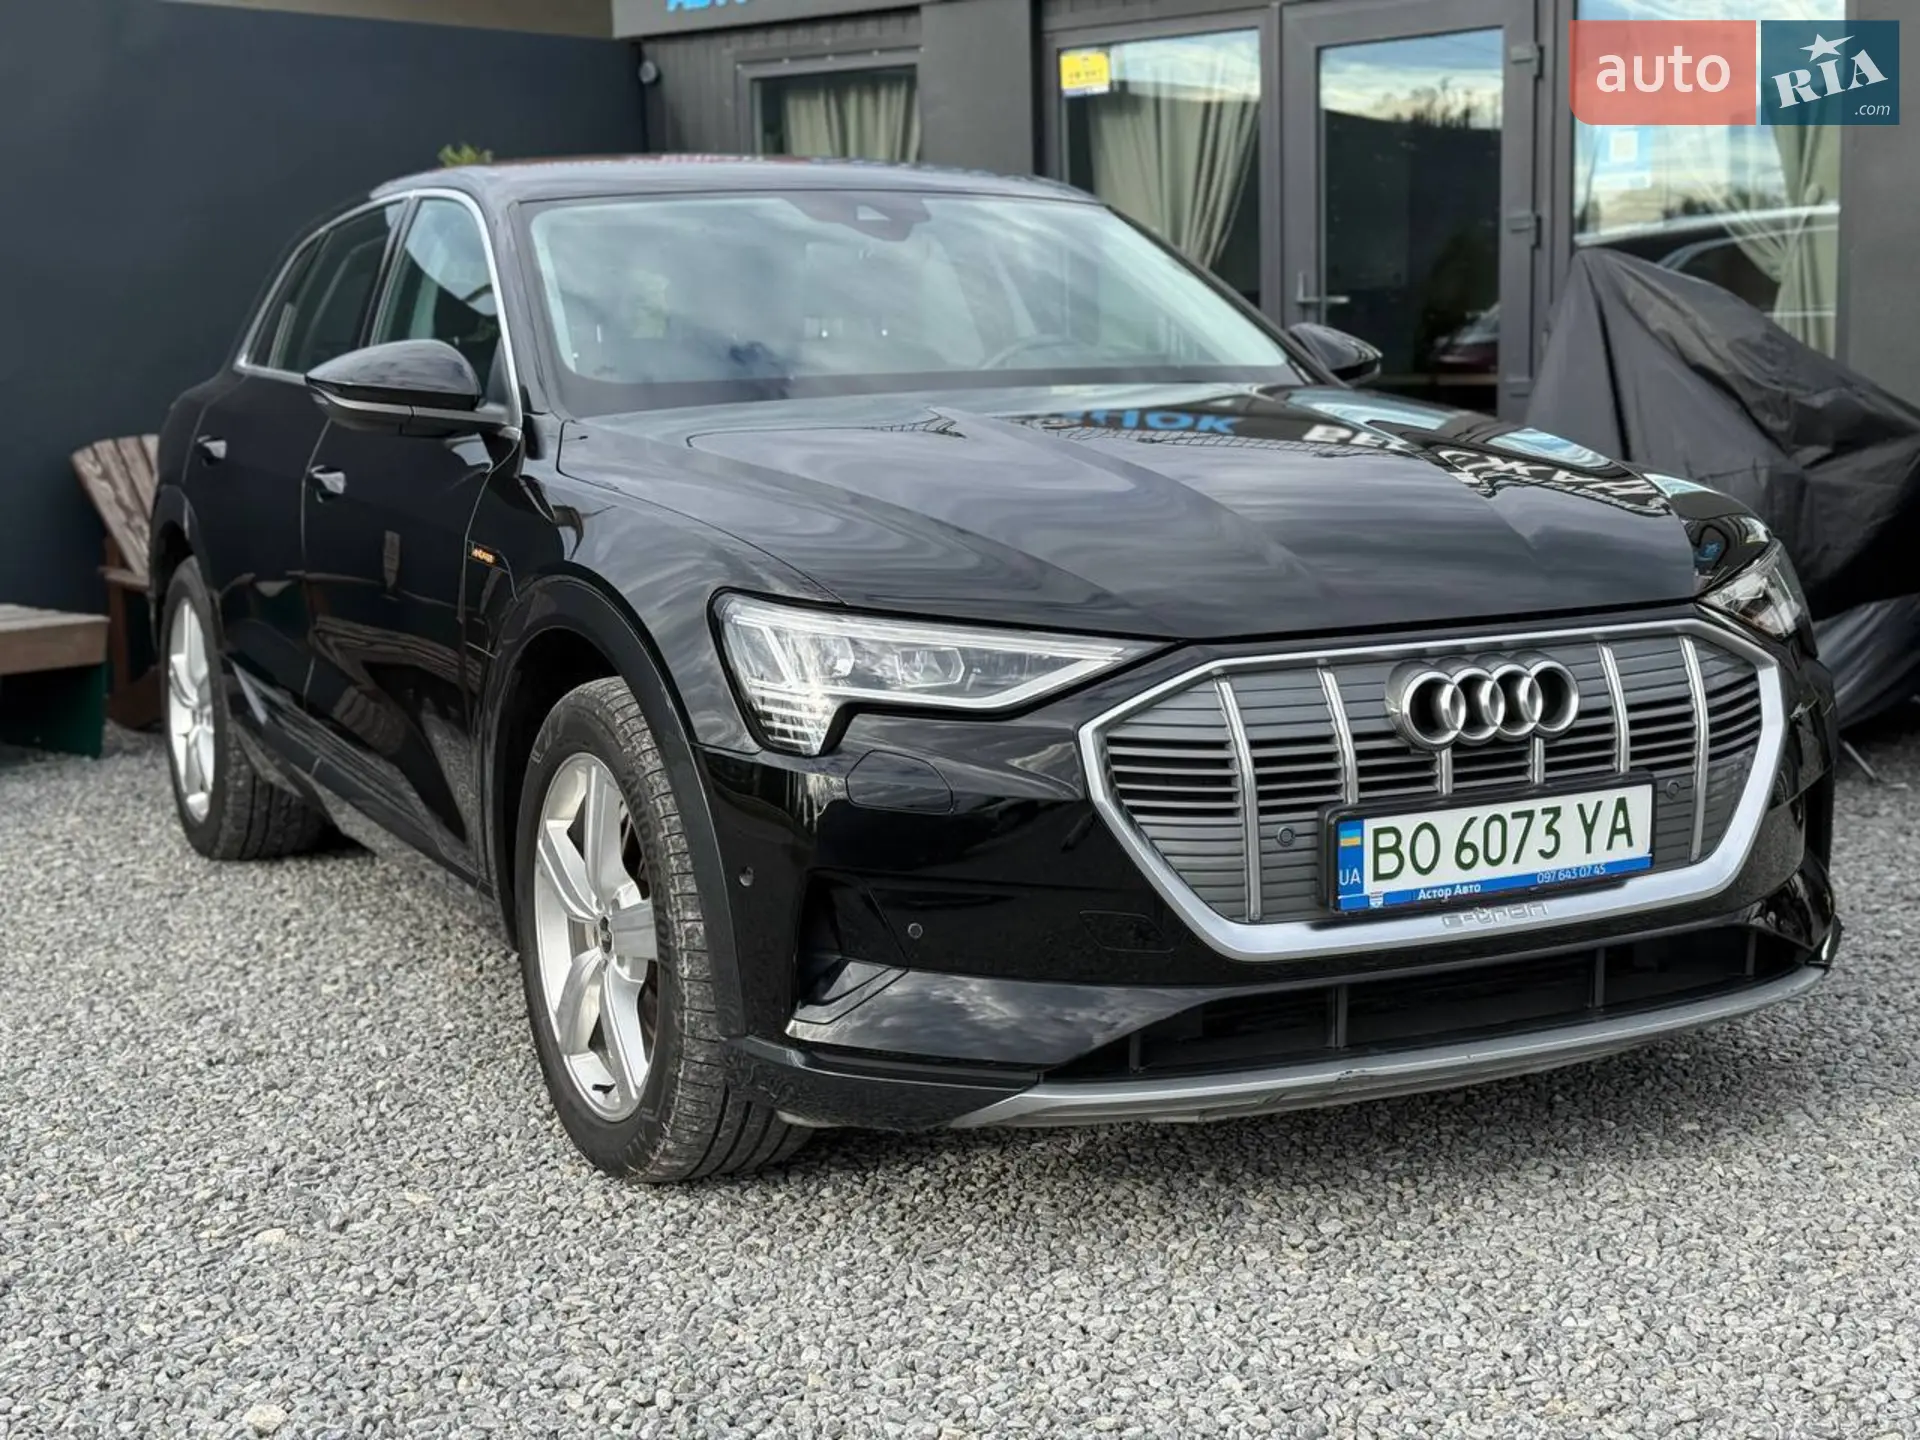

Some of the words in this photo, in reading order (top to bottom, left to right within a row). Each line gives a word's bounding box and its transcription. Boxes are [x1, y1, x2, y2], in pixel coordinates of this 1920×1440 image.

[1373, 822, 1441, 882] BO
[1454, 806, 1562, 871] 6073
[1338, 868, 1361, 886] UA
[1536, 871, 1557, 884] 097
[1417, 887, 1451, 901] Астор
[1453, 882, 1482, 896] Авто
